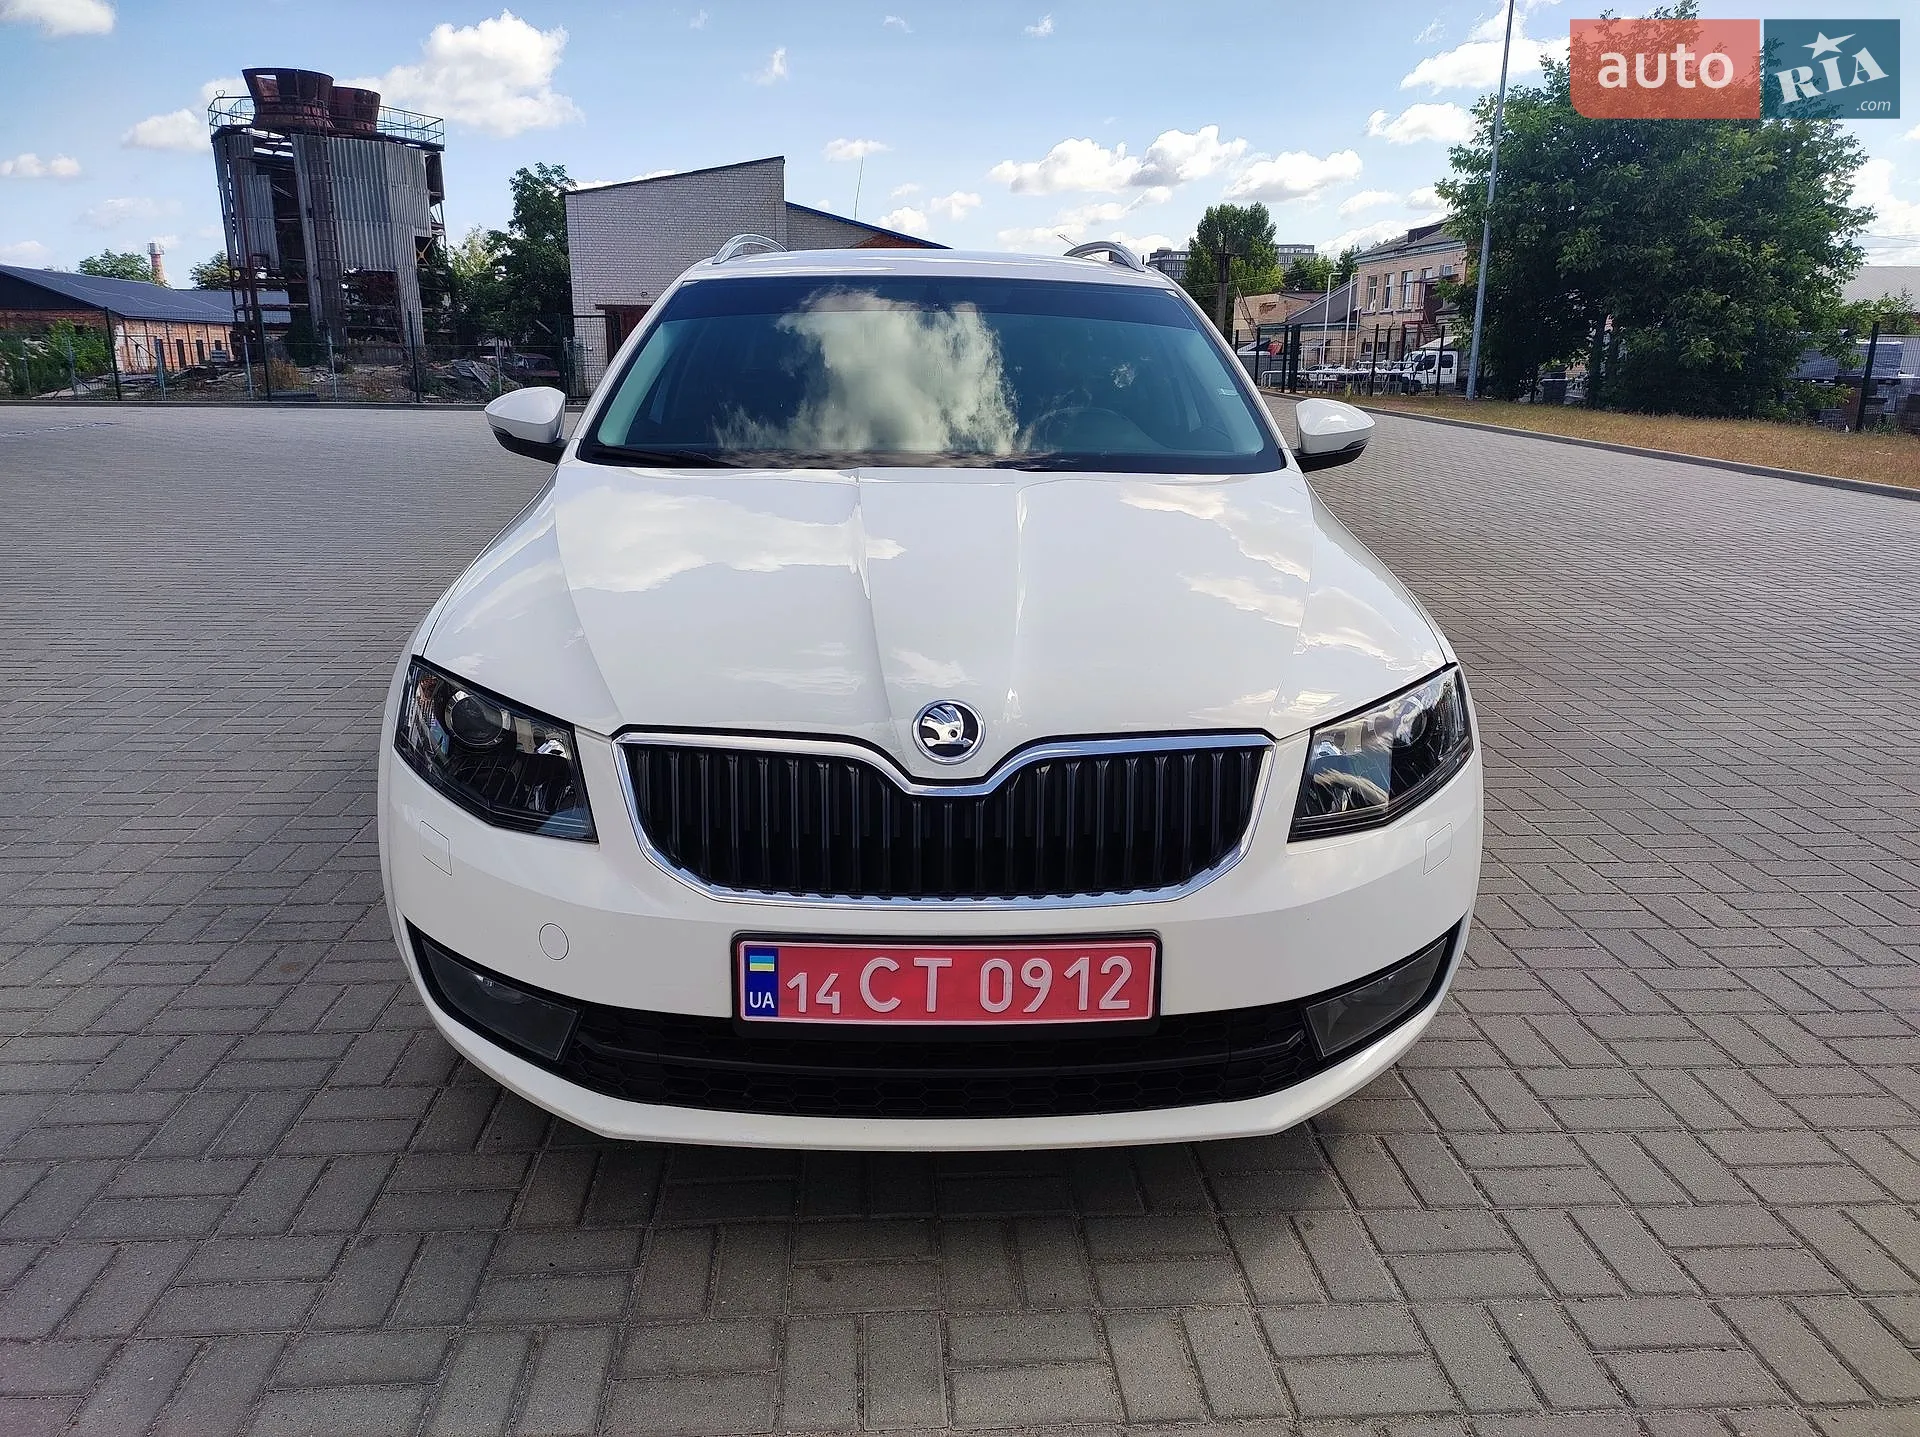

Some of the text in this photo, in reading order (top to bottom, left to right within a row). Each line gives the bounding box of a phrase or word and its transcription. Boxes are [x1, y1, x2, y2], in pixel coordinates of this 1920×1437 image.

[749, 991, 775, 1009] UA
[786, 955, 1133, 1014] 14 CT 0912
